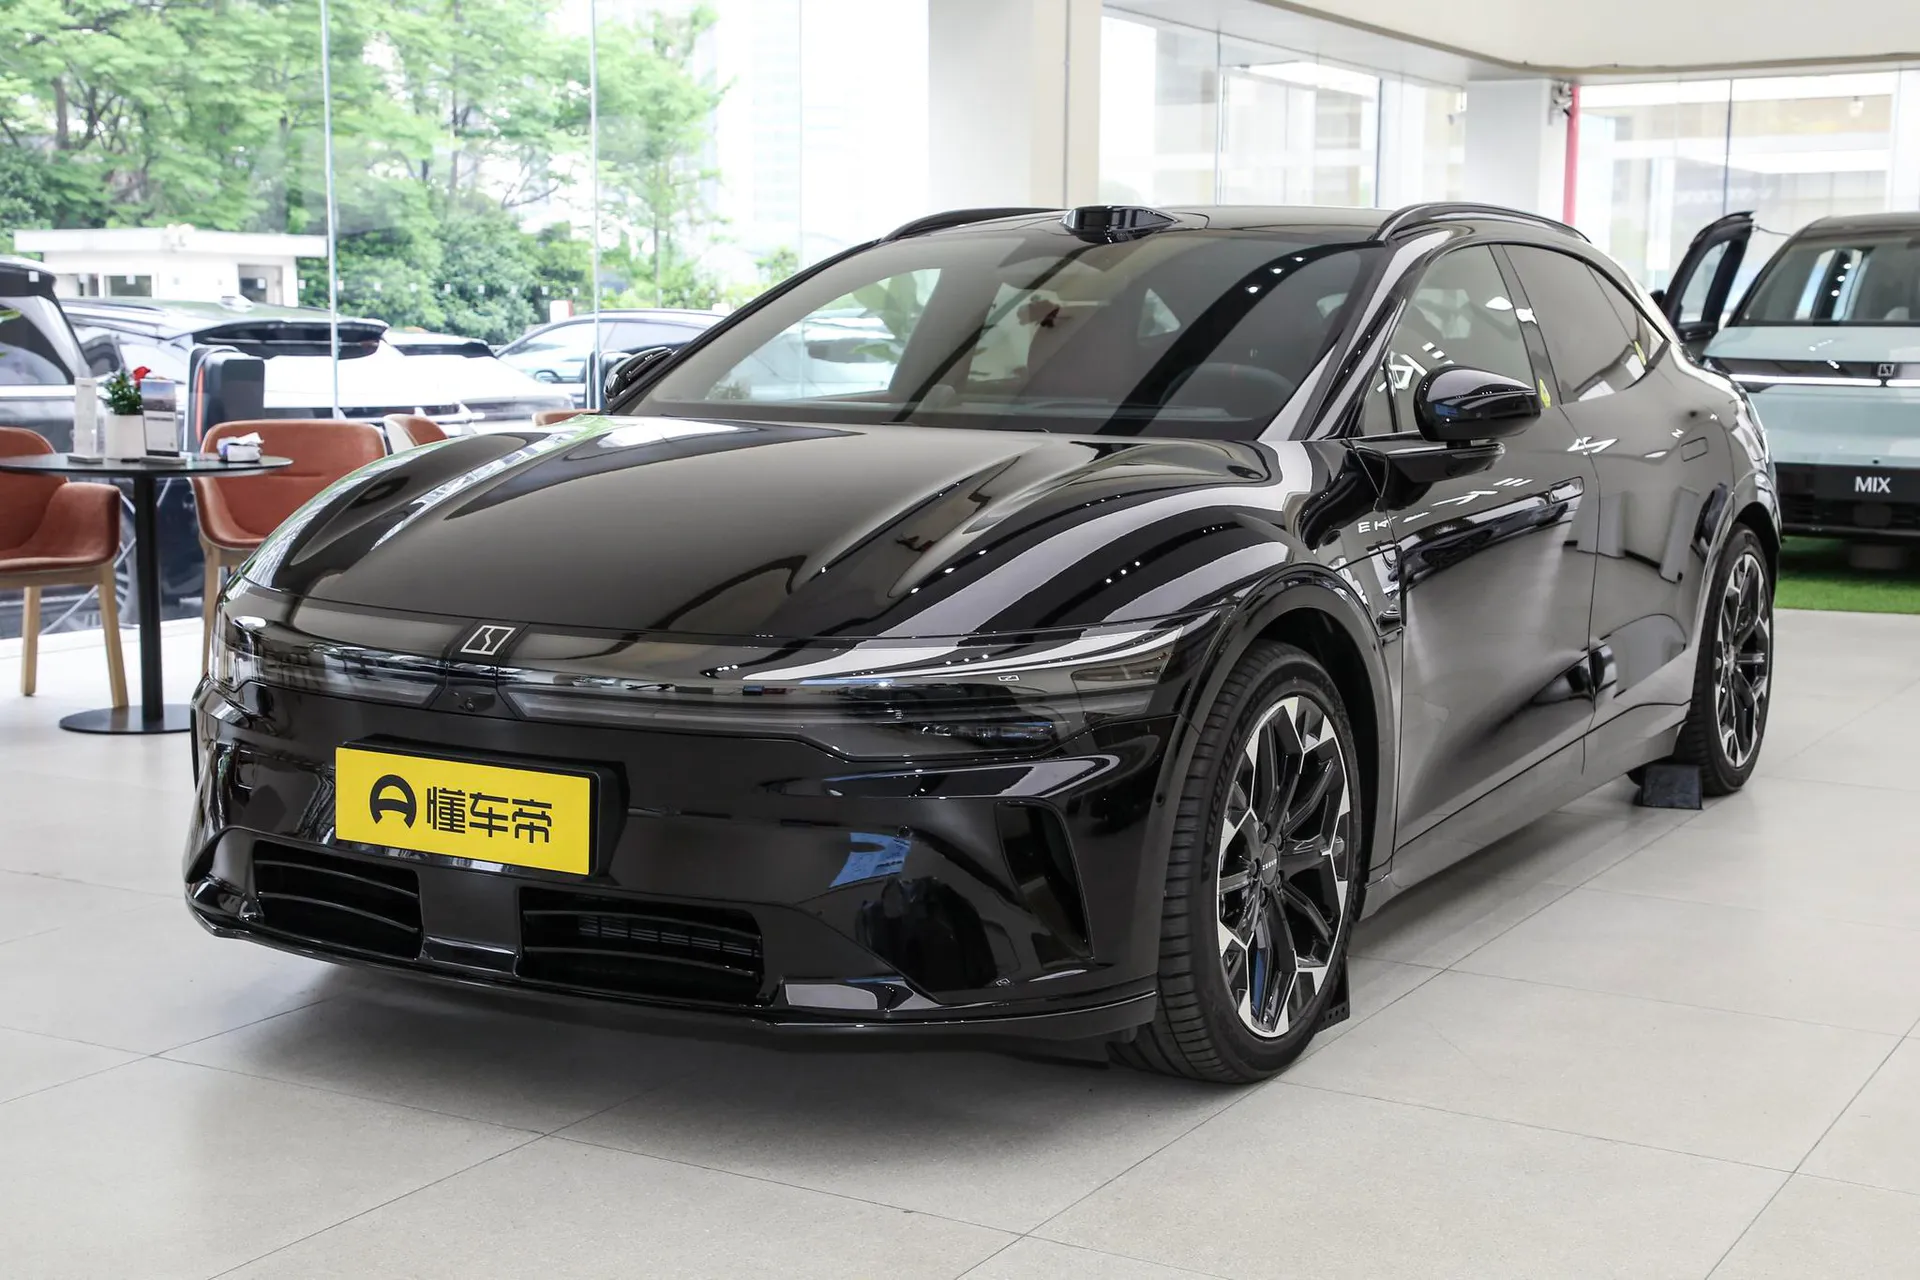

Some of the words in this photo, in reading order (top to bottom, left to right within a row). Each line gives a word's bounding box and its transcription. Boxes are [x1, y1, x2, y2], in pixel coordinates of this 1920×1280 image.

[1855, 476, 1891, 493] MIX
[427, 786, 552, 843] 懂车帝
